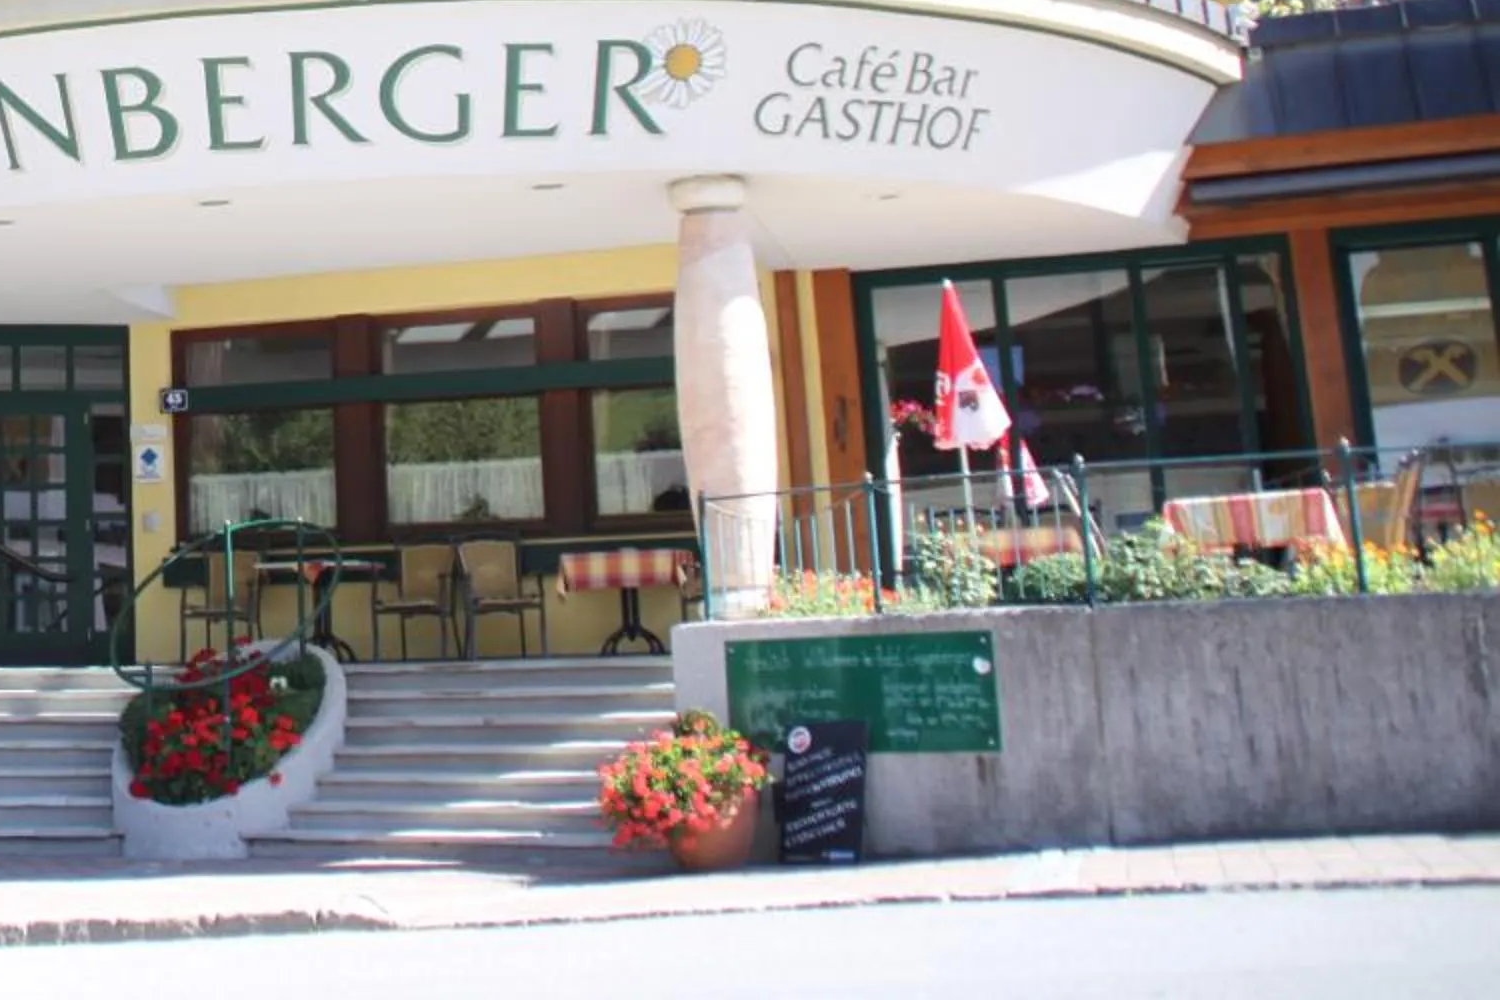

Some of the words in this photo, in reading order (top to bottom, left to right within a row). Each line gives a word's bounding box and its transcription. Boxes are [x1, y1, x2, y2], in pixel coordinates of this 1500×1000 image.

[786, 42, 900, 93] Café
[905, 52, 979, 99] Bar
[753, 91, 991, 151] GASTHOF
